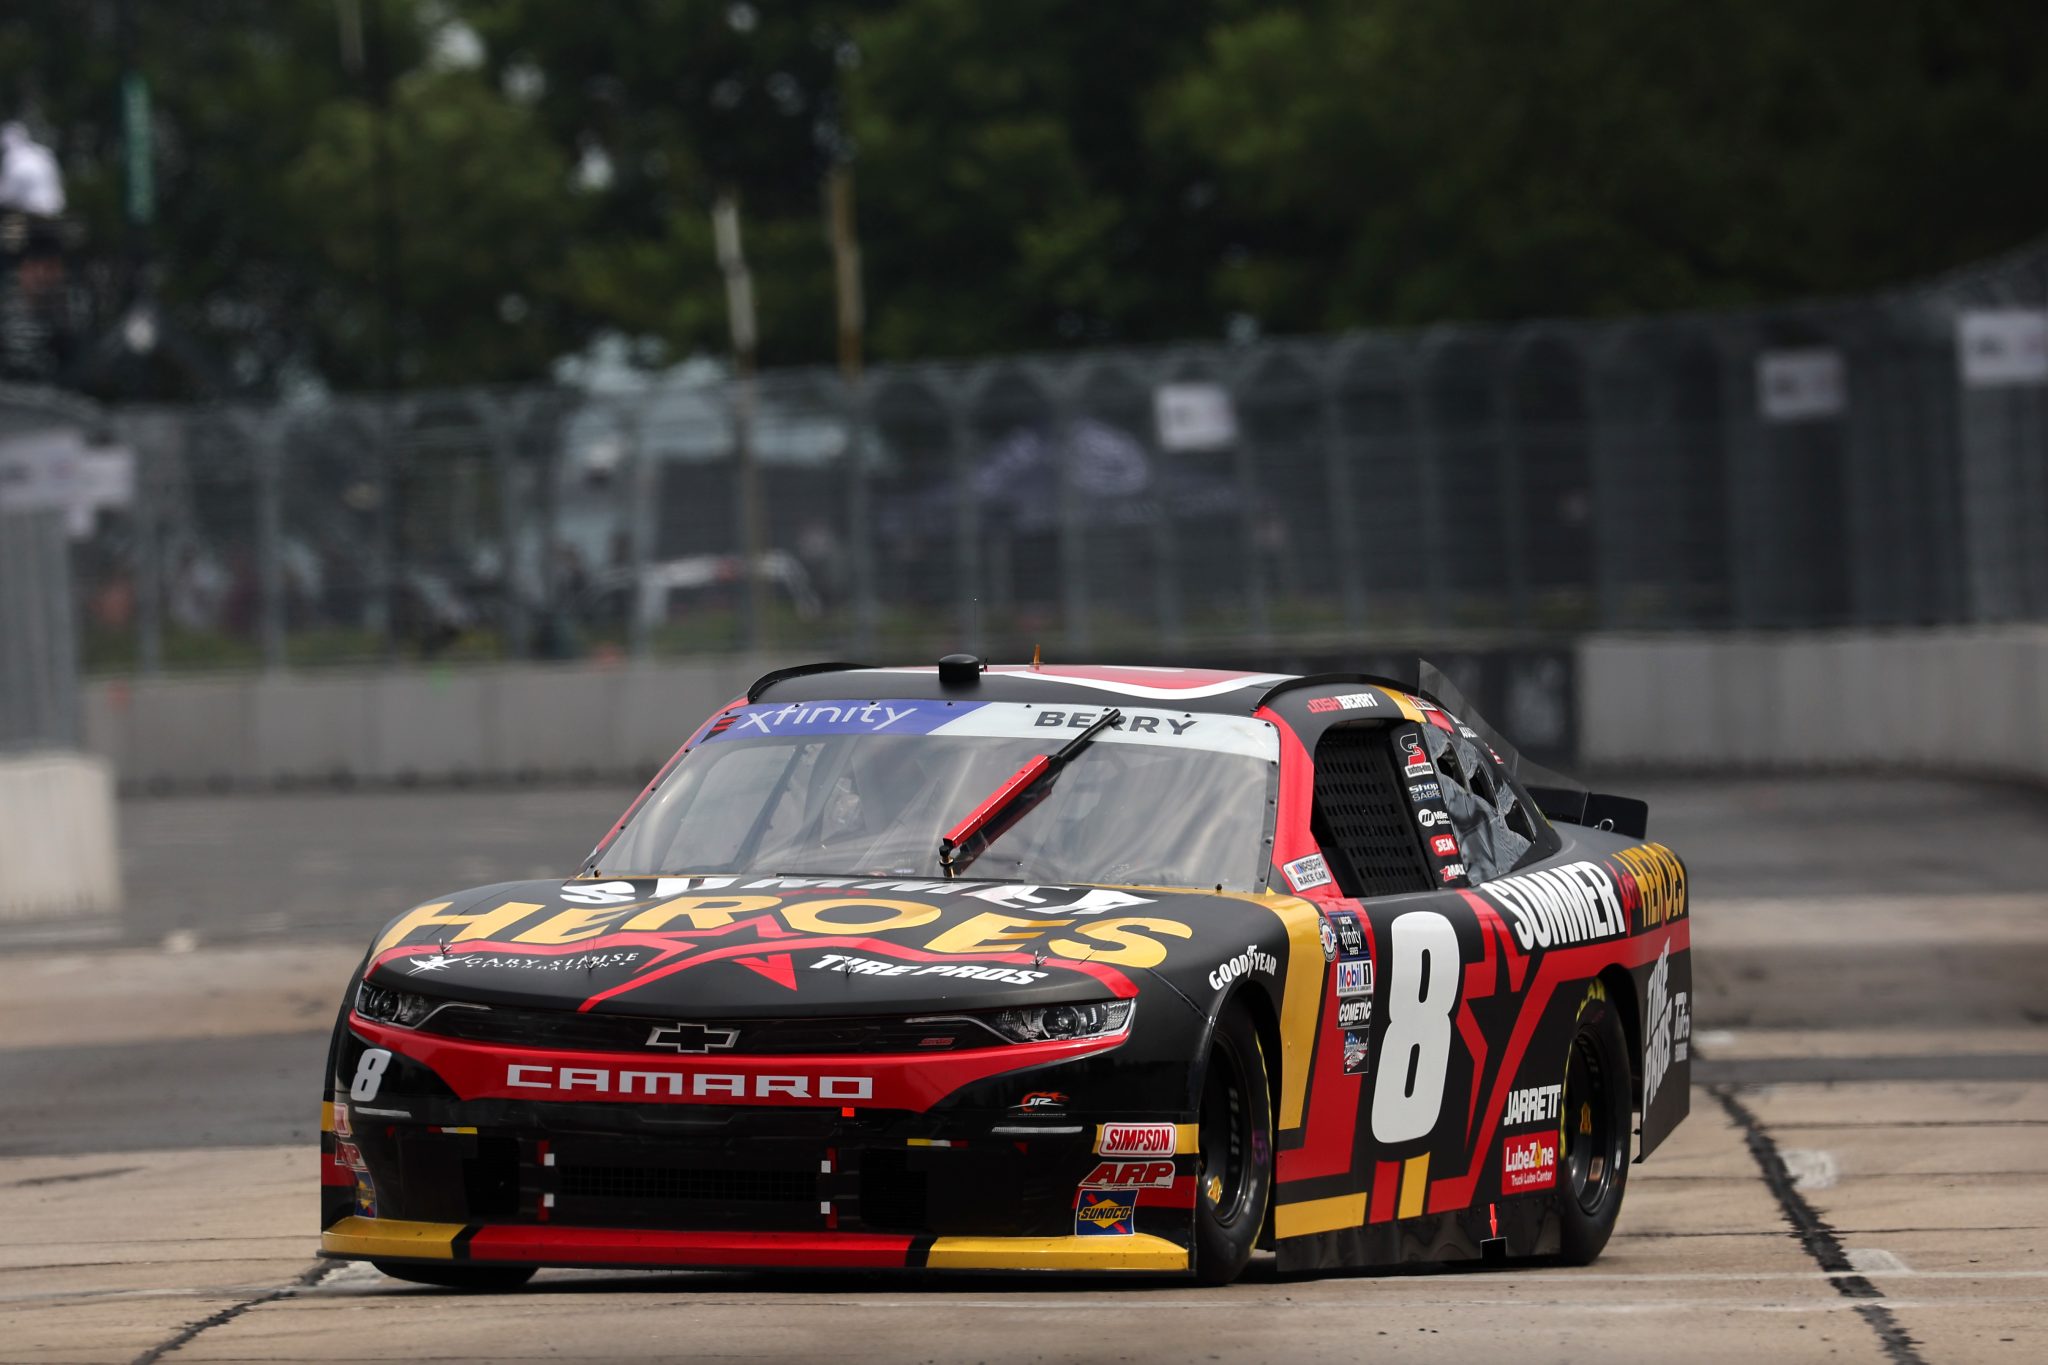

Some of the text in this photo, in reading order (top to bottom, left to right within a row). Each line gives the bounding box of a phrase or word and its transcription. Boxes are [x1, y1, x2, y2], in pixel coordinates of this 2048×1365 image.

[737, 701, 918, 734] xfinity
[1034, 711, 1198, 735] BERRY
[1409, 783, 1439, 794] Shop
[1298, 870, 1326, 885] RACE CAR
[1480, 861, 1626, 950] SUMMER
[1611, 842, 1684, 928] HEROES
[370, 895, 1193, 968] HEROES
[464, 956, 541, 966] GARY
[809, 953, 1049, 985] TIRE PROS
[1209, 944, 1277, 990] GOODYEAR
[1339, 964, 1362, 988] Mobil
[1338, 1001, 1372, 1022] COMETIC
[1371, 911, 1460, 1144] 8
[1642, 997, 1673, 1123] PROS
[351, 1048, 393, 1102] 8
[506, 1064, 873, 1099] CAMARO
[1503, 1084, 1562, 1126] JARRETT
[1106, 1129, 1171, 1151] SIMPSON
[1081, 1163, 1174, 1184] ARP
[1523, 1172, 1536, 1185] Lube
[1536, 1170, 1553, 1183] Center
[1081, 1207, 1129, 1220] SUNOCO
